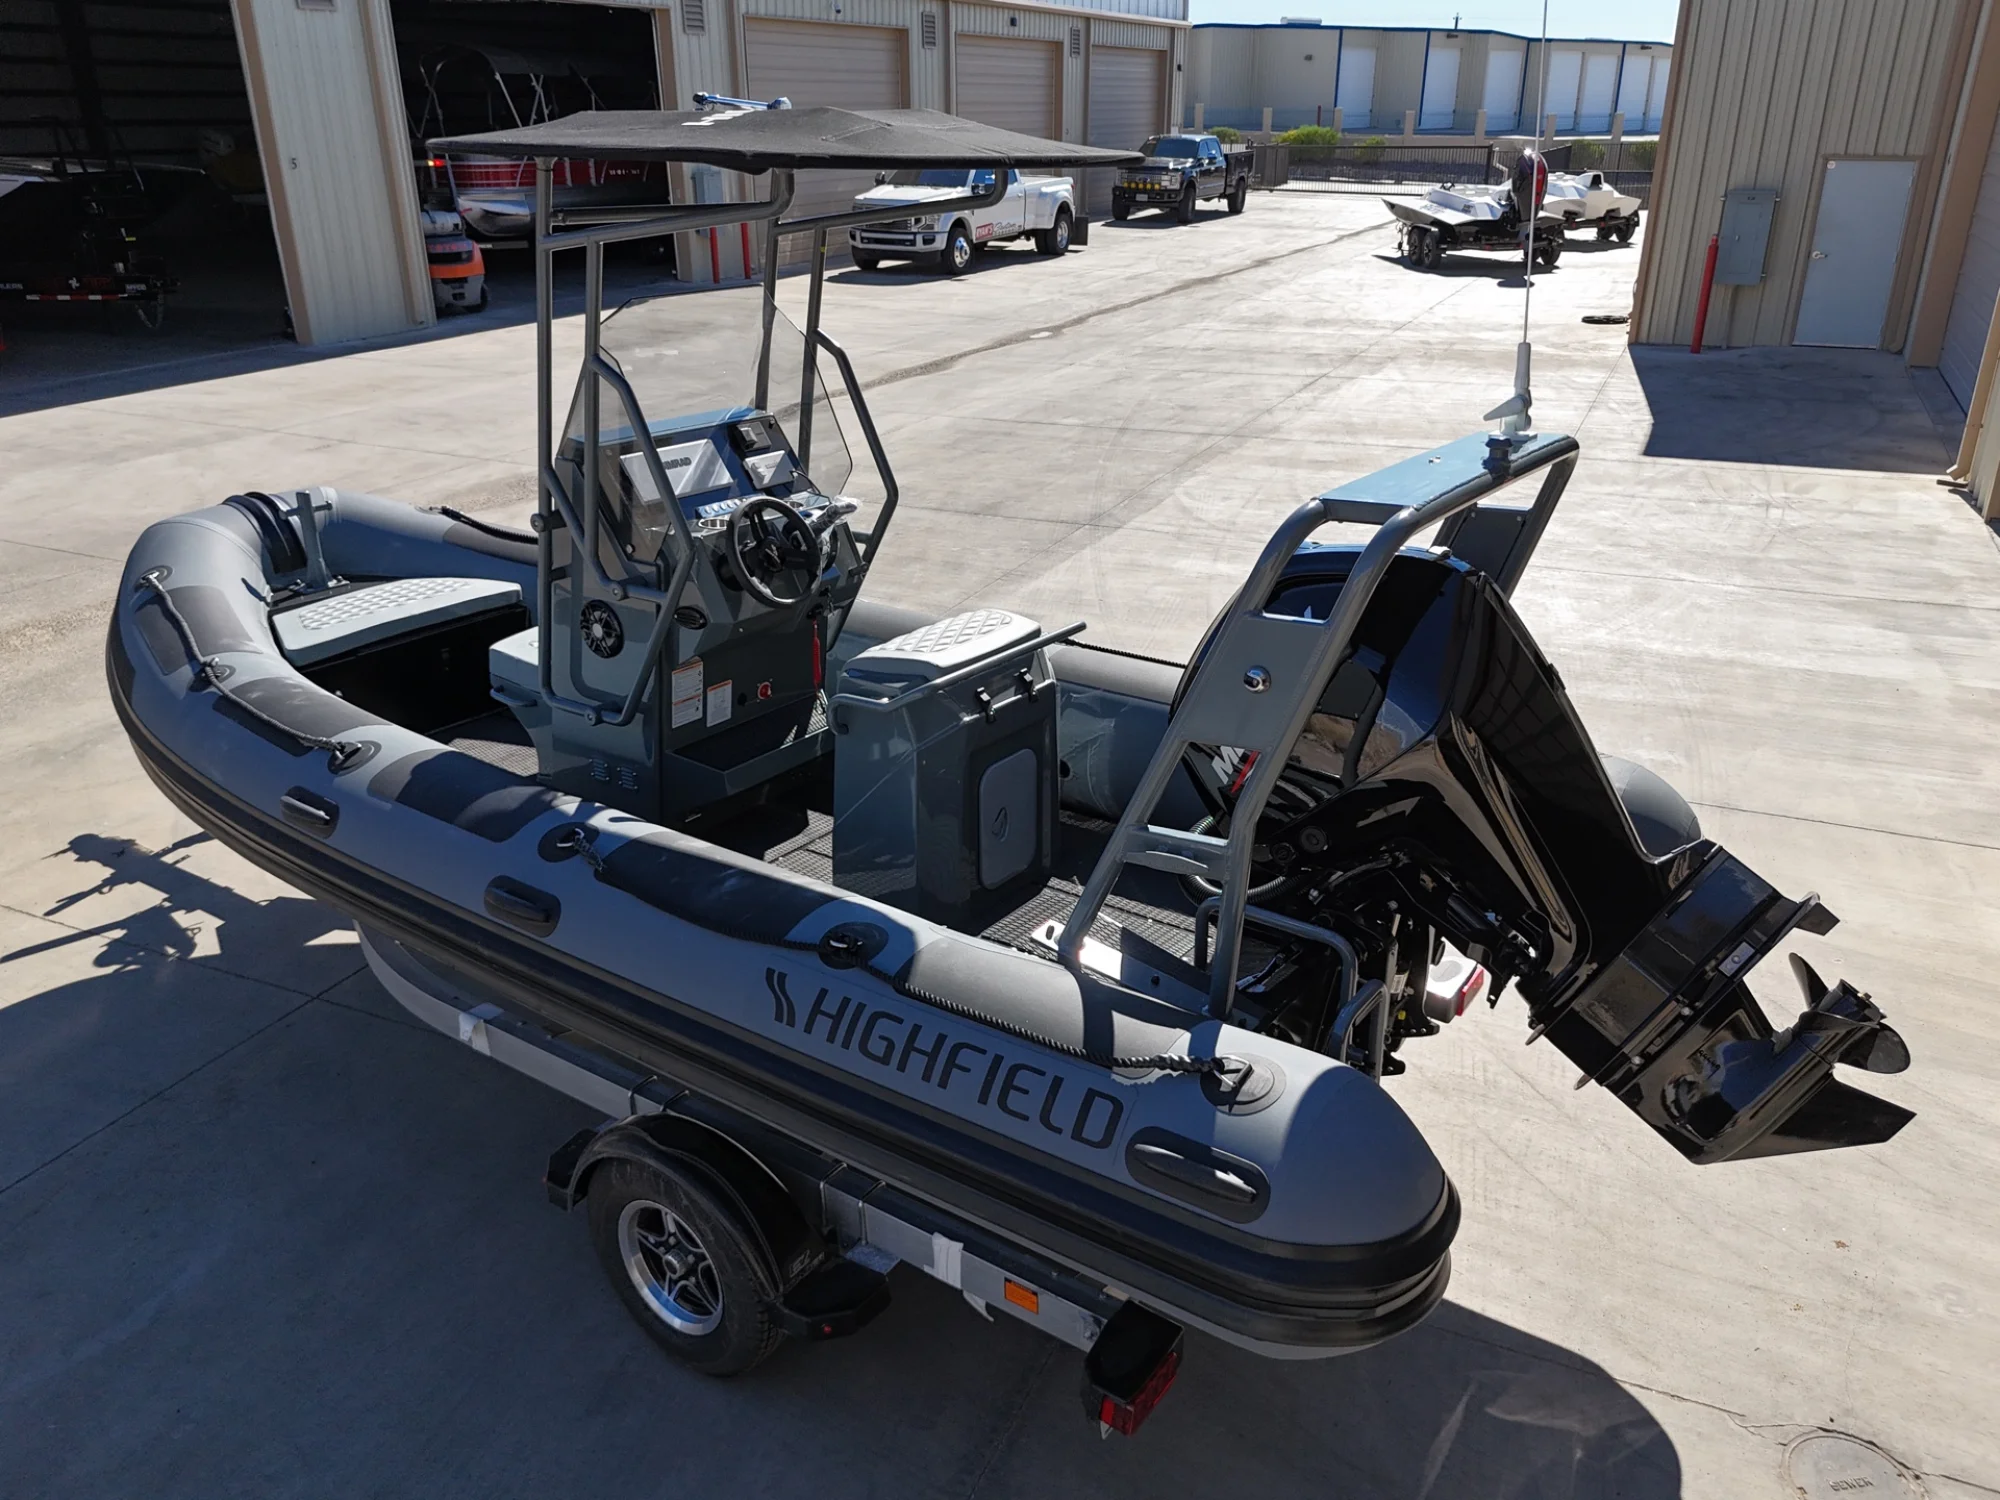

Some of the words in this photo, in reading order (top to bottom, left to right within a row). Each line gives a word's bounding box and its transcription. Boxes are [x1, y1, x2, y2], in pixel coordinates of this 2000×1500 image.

[291, 157, 298, 170] 5
[803, 987, 1125, 1150] HIGHFIELD
[1829, 1477, 1875, 1492] SEWER
